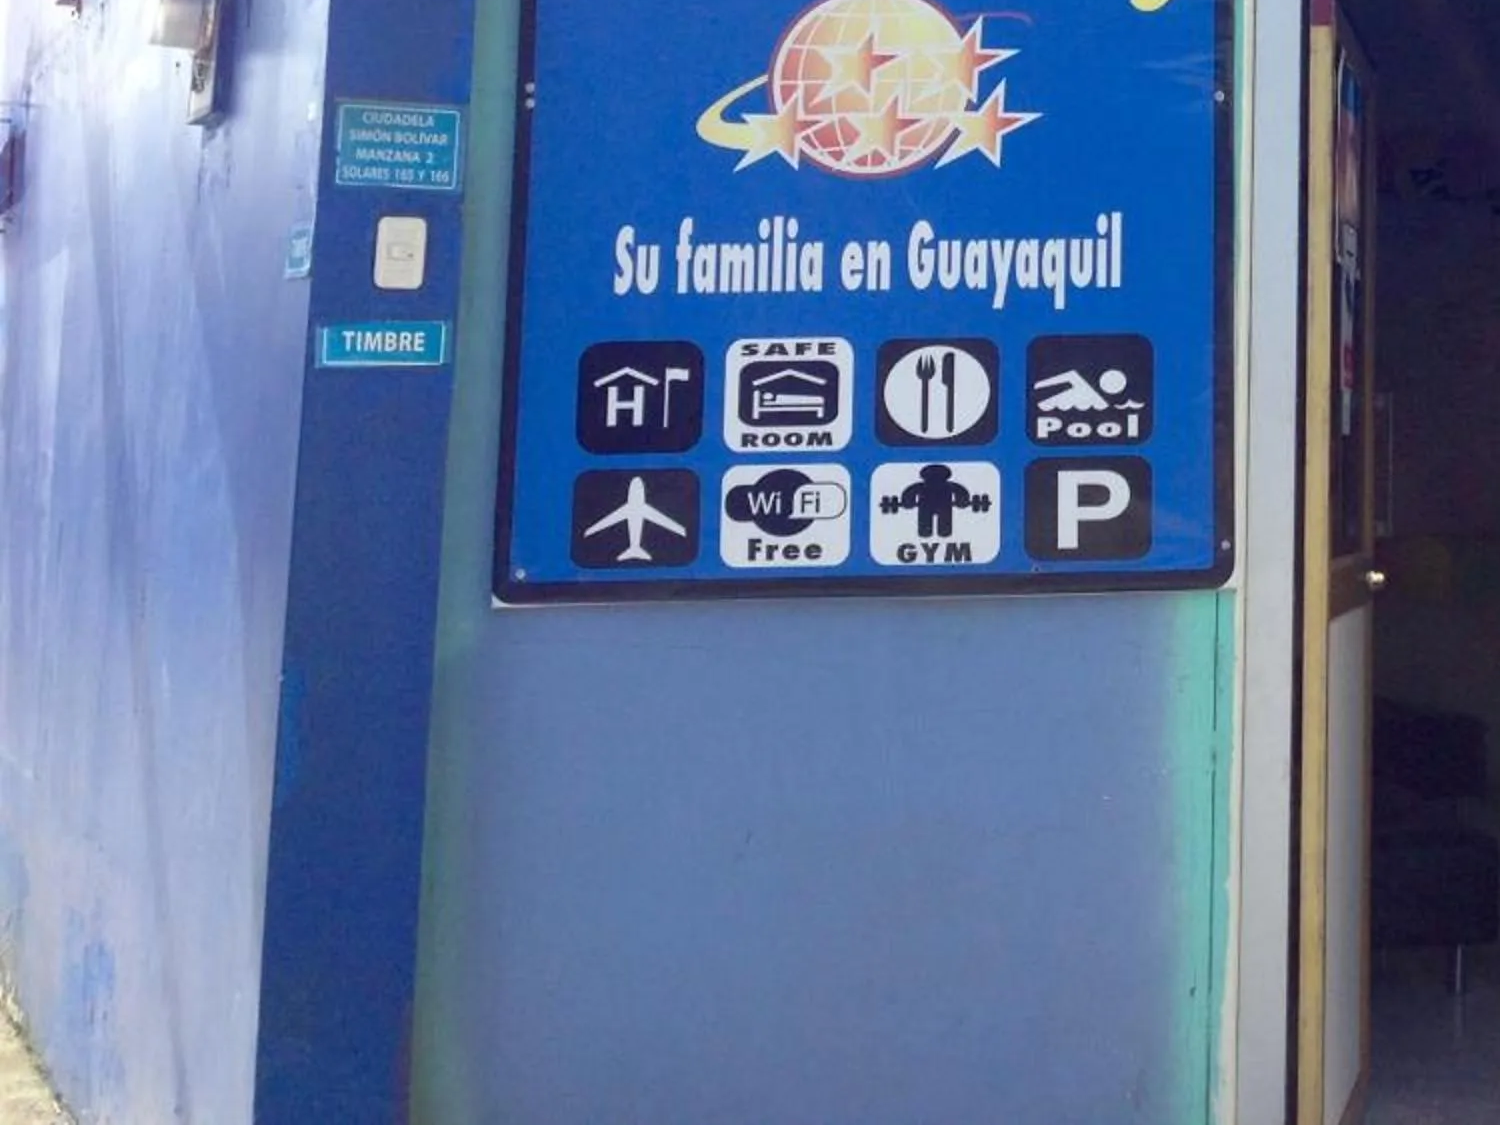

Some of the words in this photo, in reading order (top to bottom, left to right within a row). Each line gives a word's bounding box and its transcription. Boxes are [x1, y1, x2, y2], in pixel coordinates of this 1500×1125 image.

[362, 110, 435, 127] CIUDADELA
[355, 148, 421, 163] MANZANA
[613, 224, 660, 295] Su
[676, 216, 824, 294] familia
[840, 240, 892, 292] en
[907, 211, 1123, 311] Guayaquil
[342, 330, 426, 353] TIMBRE
[739, 342, 838, 357] SAFE
[1036, 413, 1140, 439] Pool
[740, 432, 834, 448] ROOM
[1057, 469, 1132, 550] P
[747, 538, 824, 562] Free
[897, 542, 973, 564] GYM
